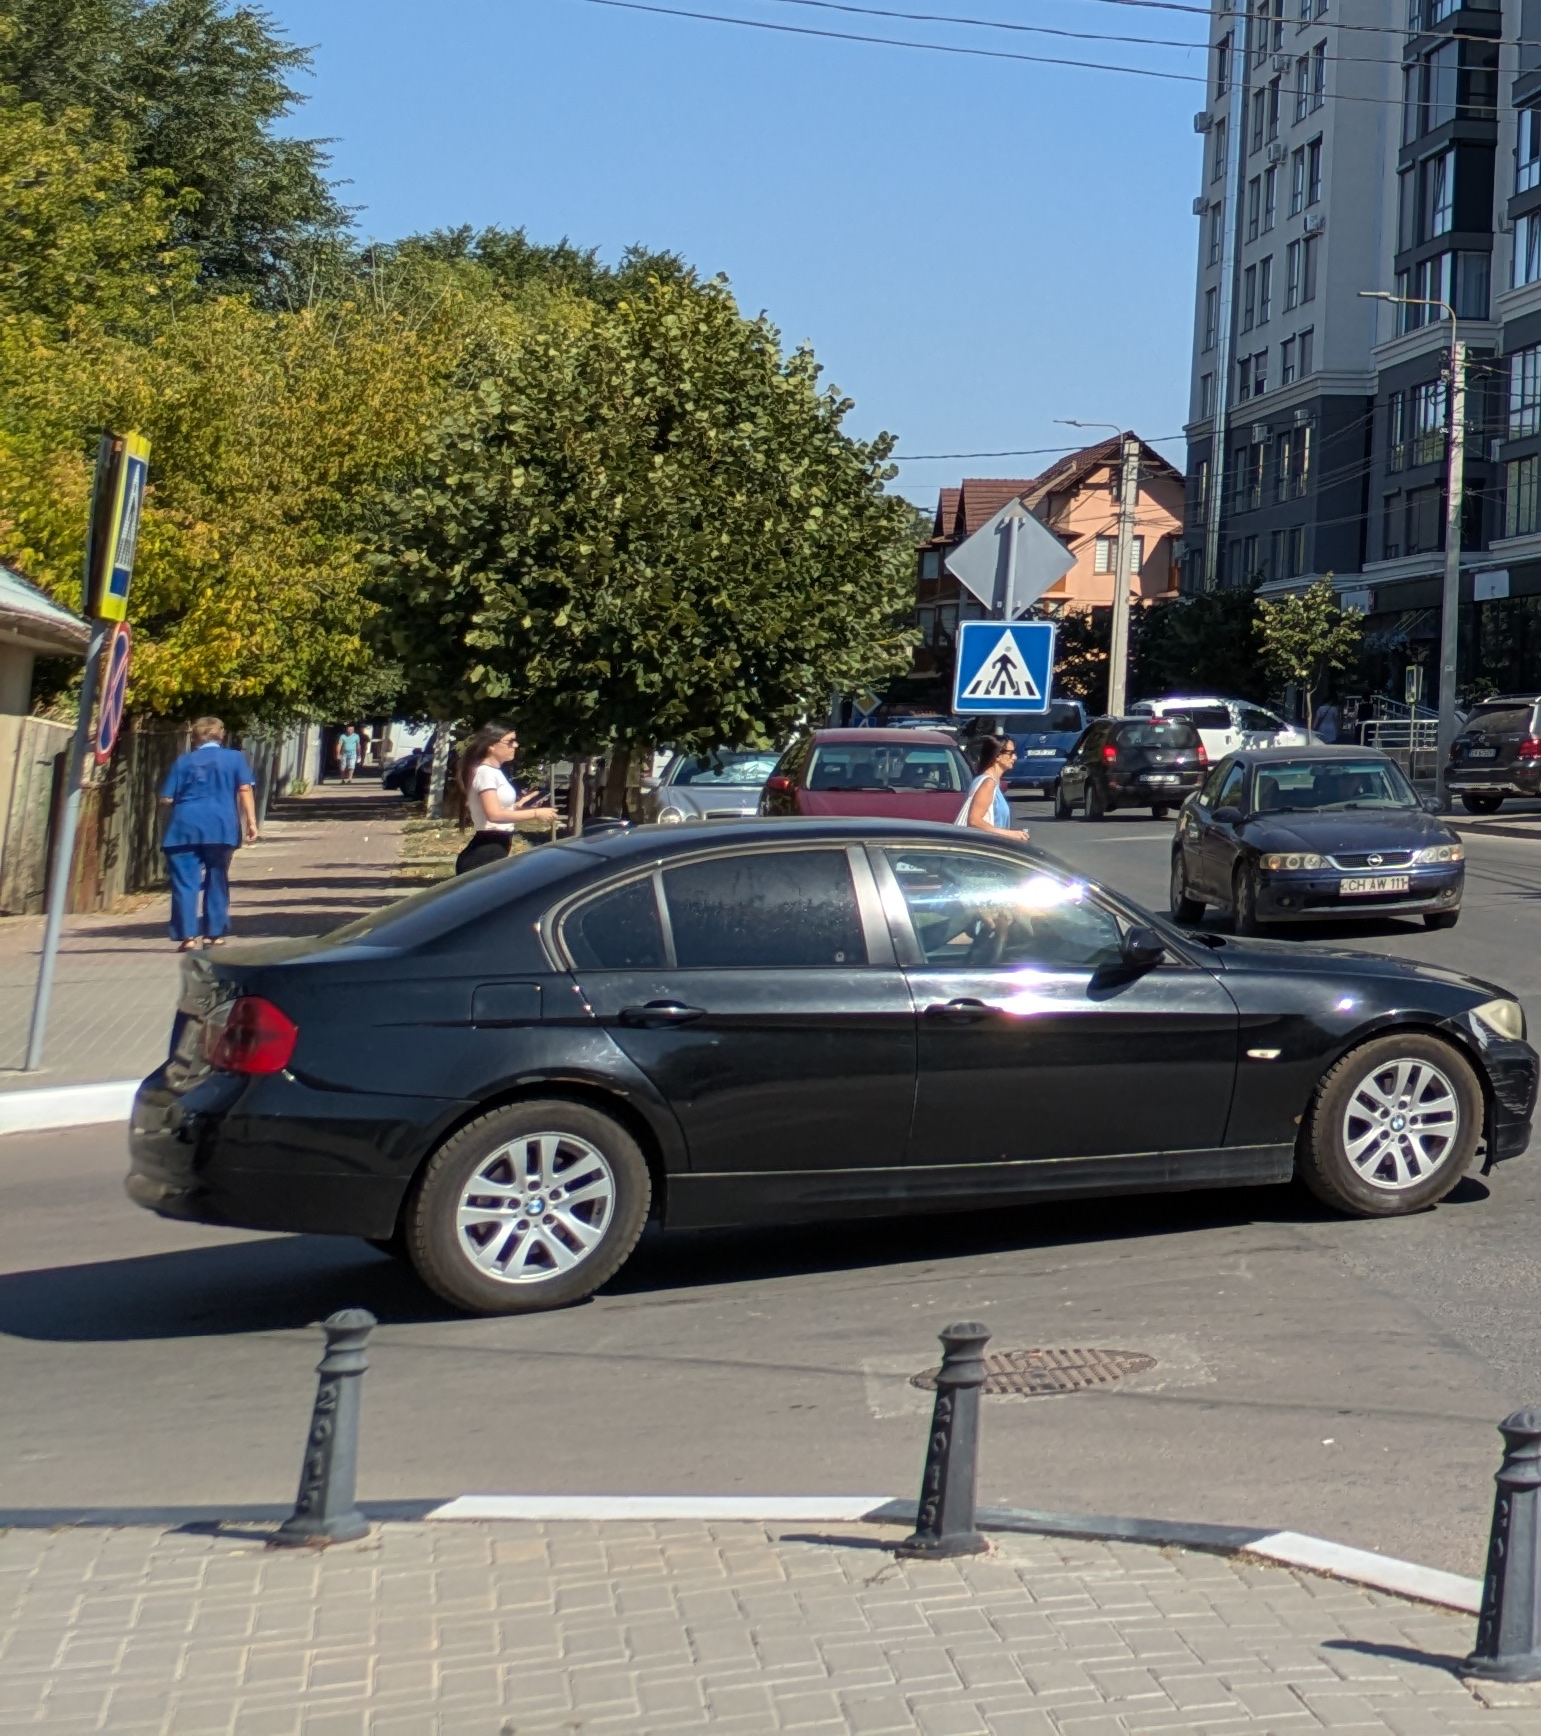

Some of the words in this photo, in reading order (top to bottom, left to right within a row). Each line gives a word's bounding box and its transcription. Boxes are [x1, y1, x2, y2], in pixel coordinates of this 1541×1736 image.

[1348, 879, 1366, 891] CH
[1369, 877, 1387, 890] AW
[1391, 876, 1406, 890] 111
